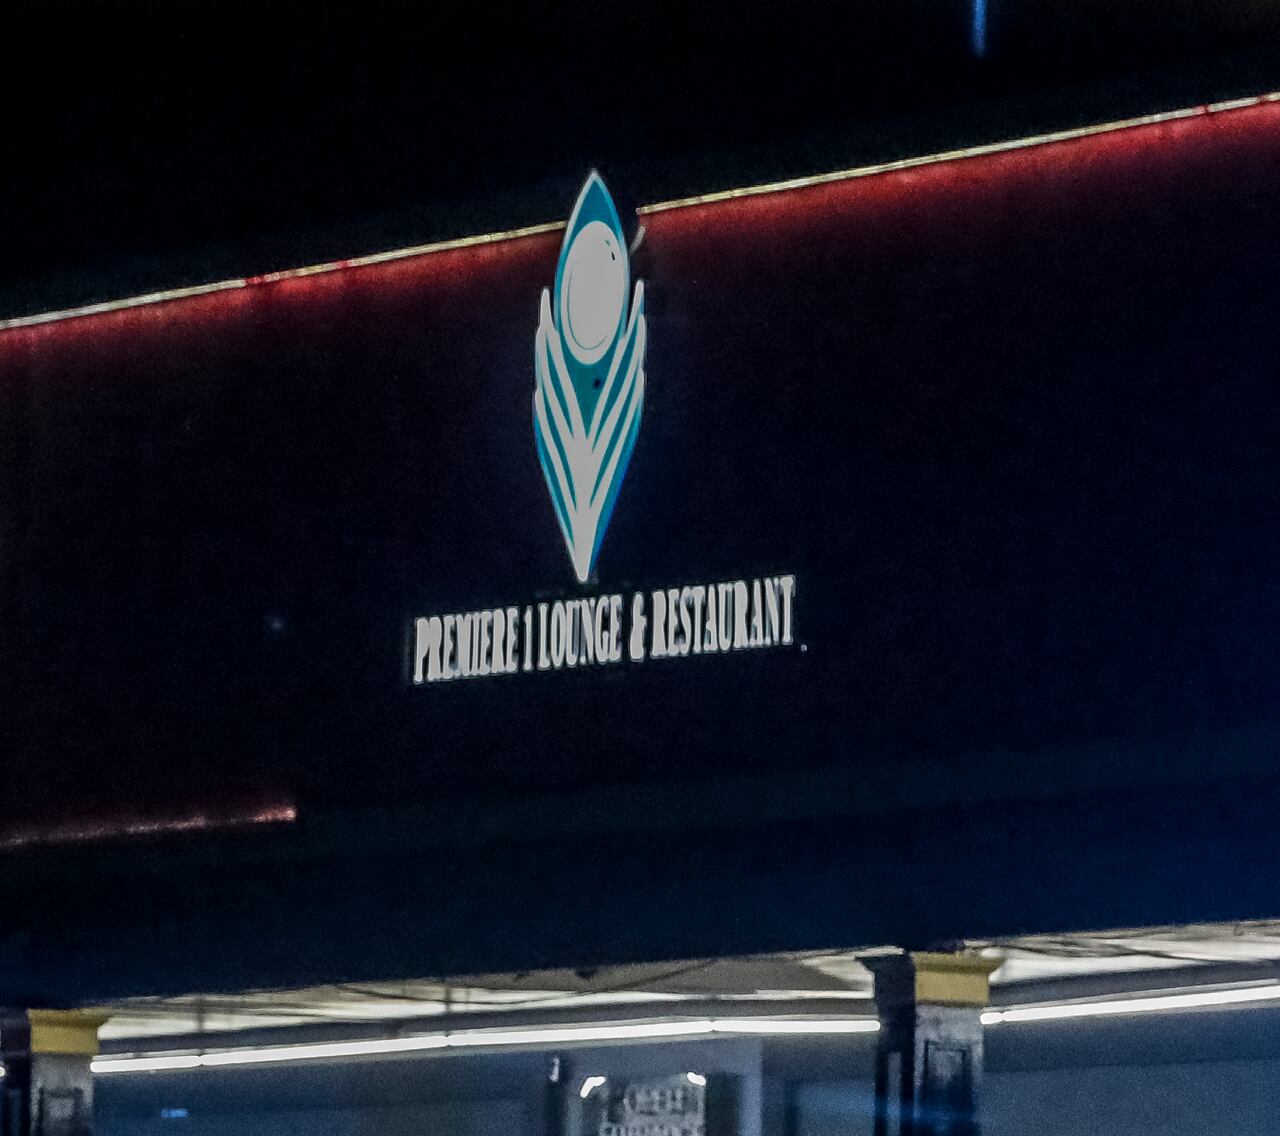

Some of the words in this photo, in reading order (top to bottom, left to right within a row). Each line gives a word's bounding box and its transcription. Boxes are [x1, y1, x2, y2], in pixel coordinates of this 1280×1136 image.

[414, 607, 518, 683] PREMIERE
[523, 605, 533, 671] 1
[537, 594, 622, 670] LOUNGE
[630, 591, 647, 661] &
[650, 575, 796, 657] RESTAURANT
